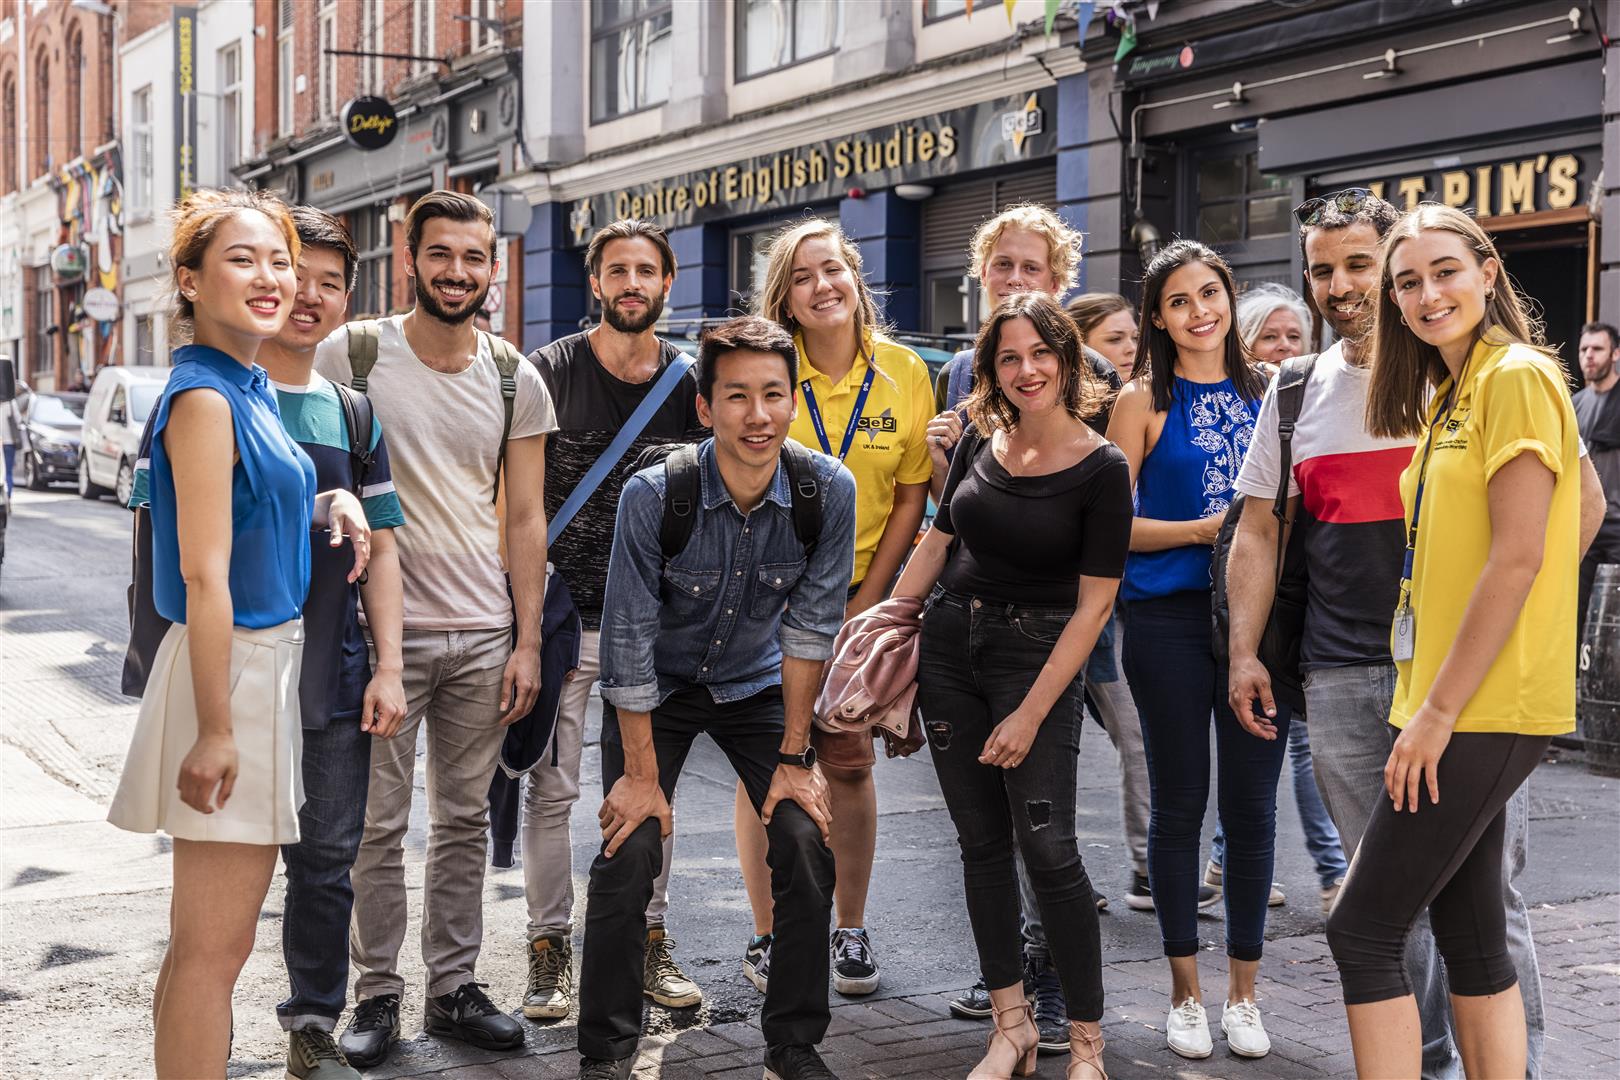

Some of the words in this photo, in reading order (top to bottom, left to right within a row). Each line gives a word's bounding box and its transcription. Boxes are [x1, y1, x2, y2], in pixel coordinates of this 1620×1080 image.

[616, 184, 688, 221] Centre
[694, 170, 718, 207] of
[725, 148, 824, 204] English
[835, 126, 955, 178] Studies
[1442, 153, 1578, 217] PIM'S
[858, 417, 893, 428] ces
